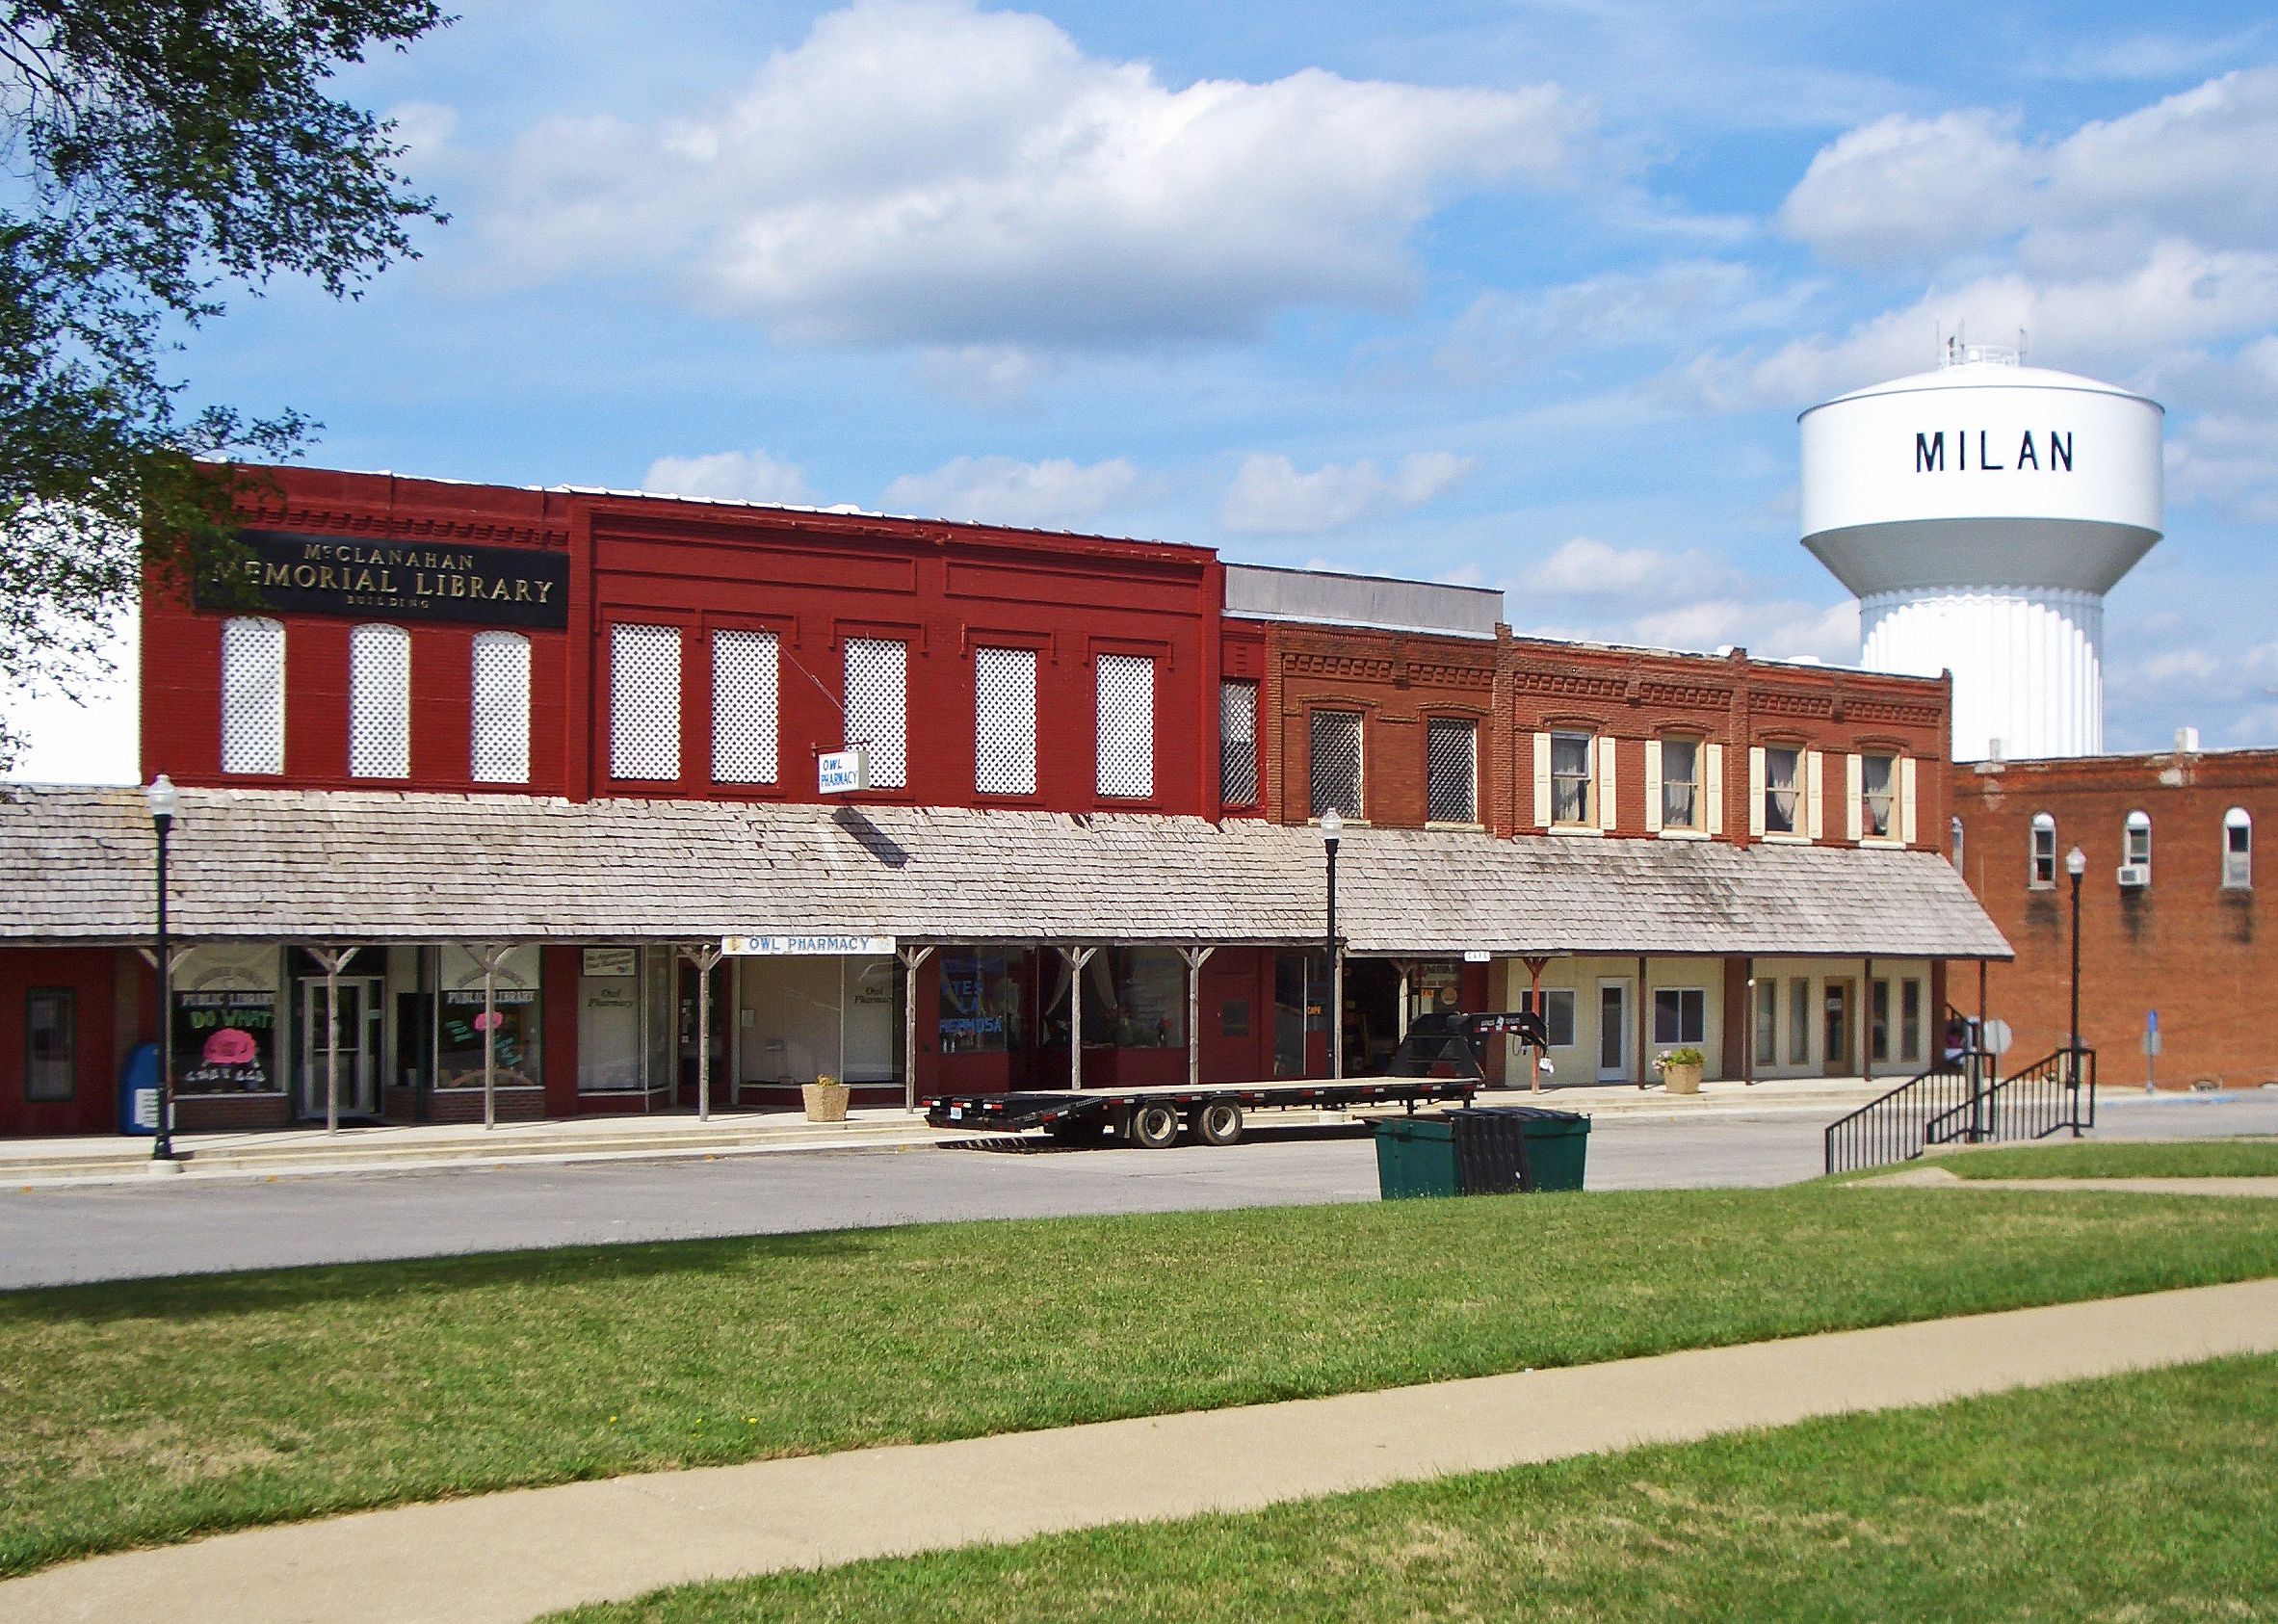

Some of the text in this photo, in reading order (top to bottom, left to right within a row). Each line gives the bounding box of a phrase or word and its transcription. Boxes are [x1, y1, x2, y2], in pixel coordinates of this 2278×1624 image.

[1916, 430, 2073, 473] MILAN
[210, 561, 554, 604] MEMORIAL LIBRARY
[346, 594, 430, 609] BUILDING
[823, 758, 843, 772] OWL
[821, 770, 858, 787] PHARMACY
[748, 937, 870, 952] OWL PHARMACY
